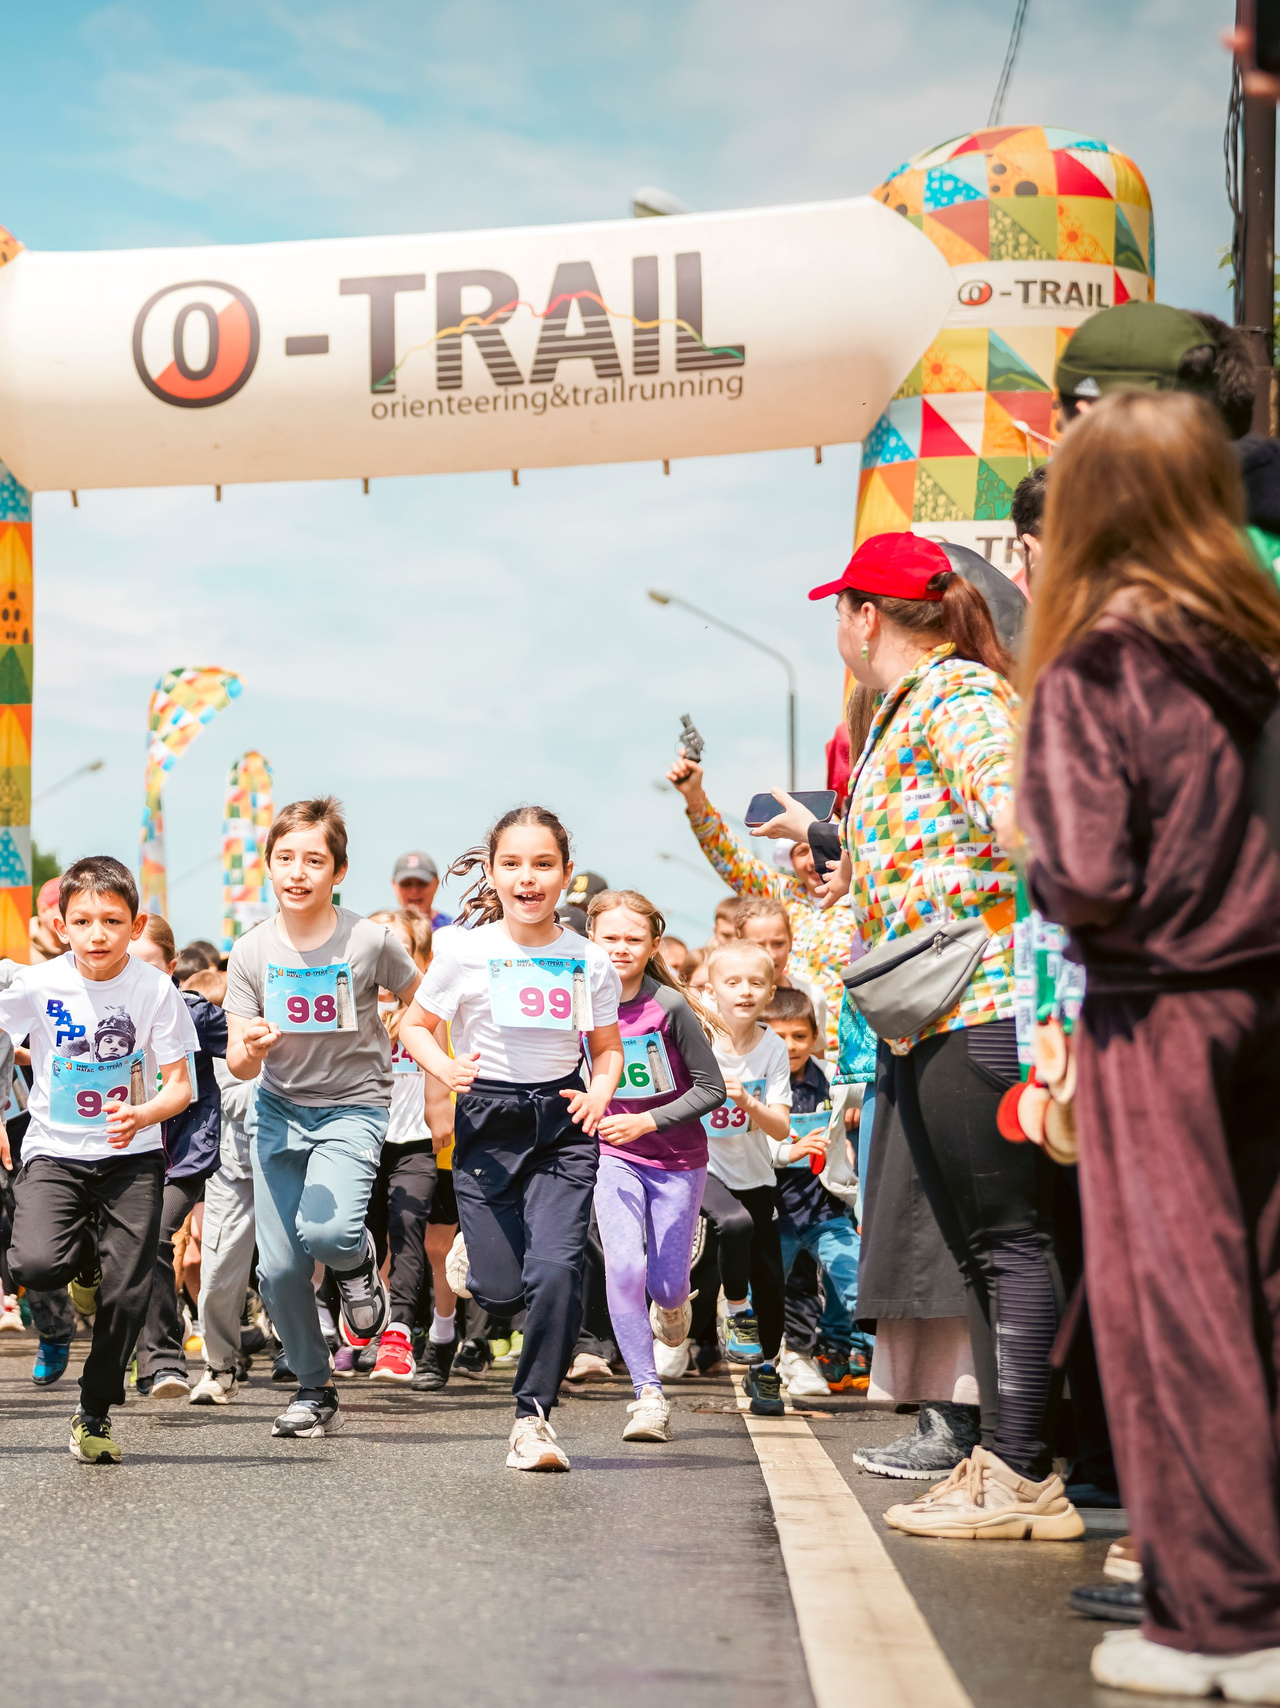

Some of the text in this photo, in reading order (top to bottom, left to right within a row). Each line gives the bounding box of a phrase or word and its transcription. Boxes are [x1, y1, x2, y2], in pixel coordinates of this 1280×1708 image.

[371, 371, 745, 420] orienteering&trailrunning
[286, 994, 337, 1024] 98
[519, 986, 571, 1019] 99
[710, 1106, 747, 1129] 83
